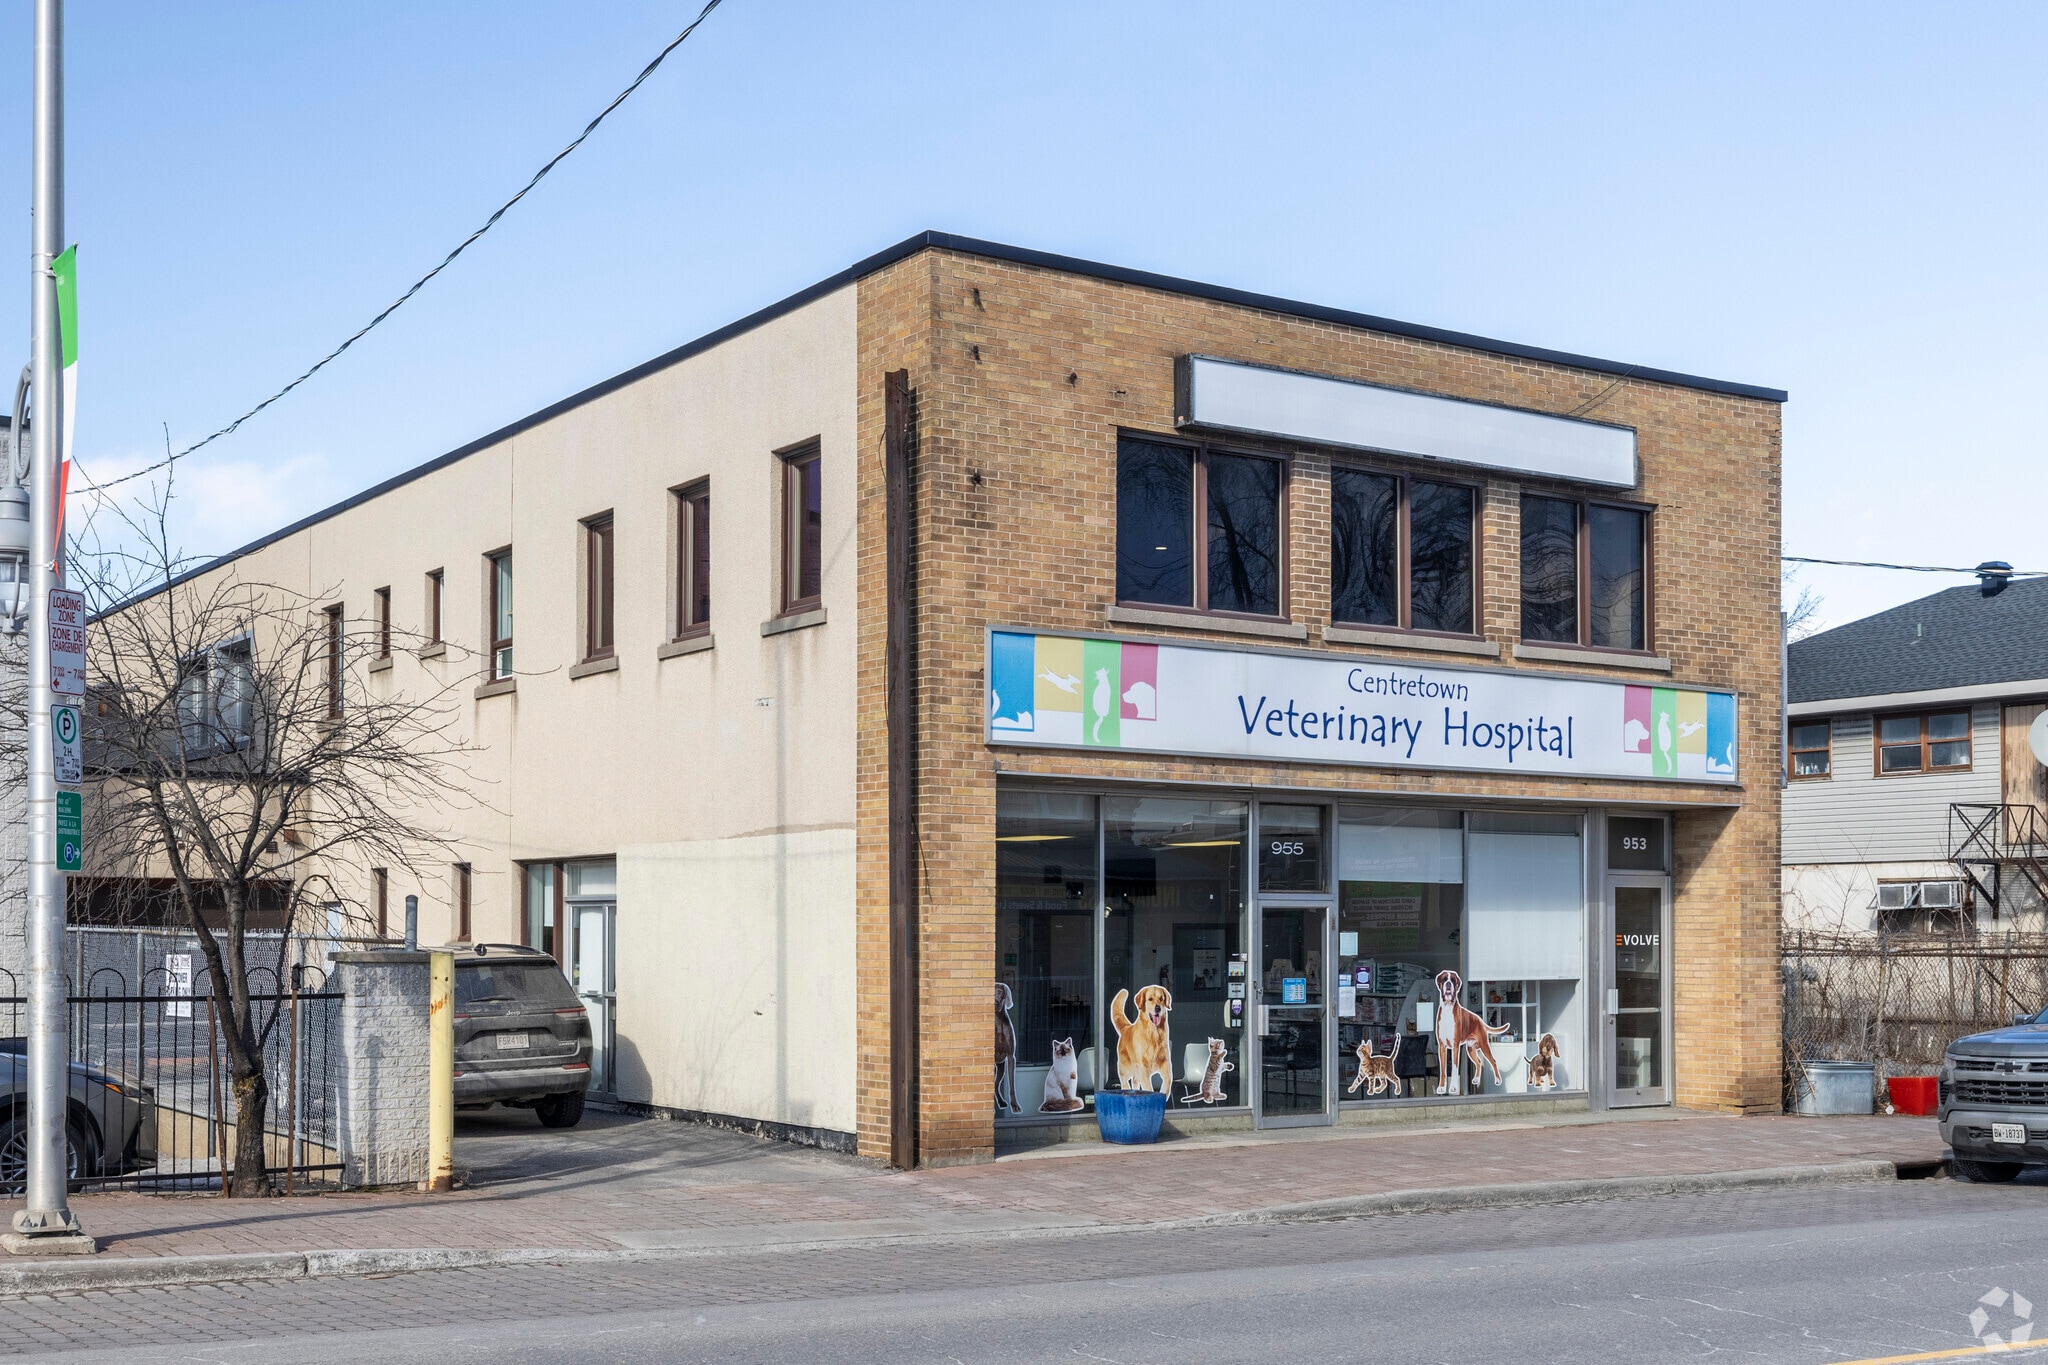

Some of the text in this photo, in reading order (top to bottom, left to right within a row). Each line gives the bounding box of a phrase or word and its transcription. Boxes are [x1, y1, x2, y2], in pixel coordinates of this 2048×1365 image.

[52, 596, 81, 612] LOADING
[58, 610, 76, 624] ZONE
[52, 627, 82, 642] ZONE DE
[52, 640, 83, 654] CHARGEMENT
[1347, 668, 1469, 702] Centretown
[63, 718, 71, 736] P
[1237, 694, 1574, 764] Veterinary Hospital
[1271, 841, 1304, 856] 955
[1623, 837, 1647, 850] 953
[1616, 934, 1660, 946] EVOLVE
